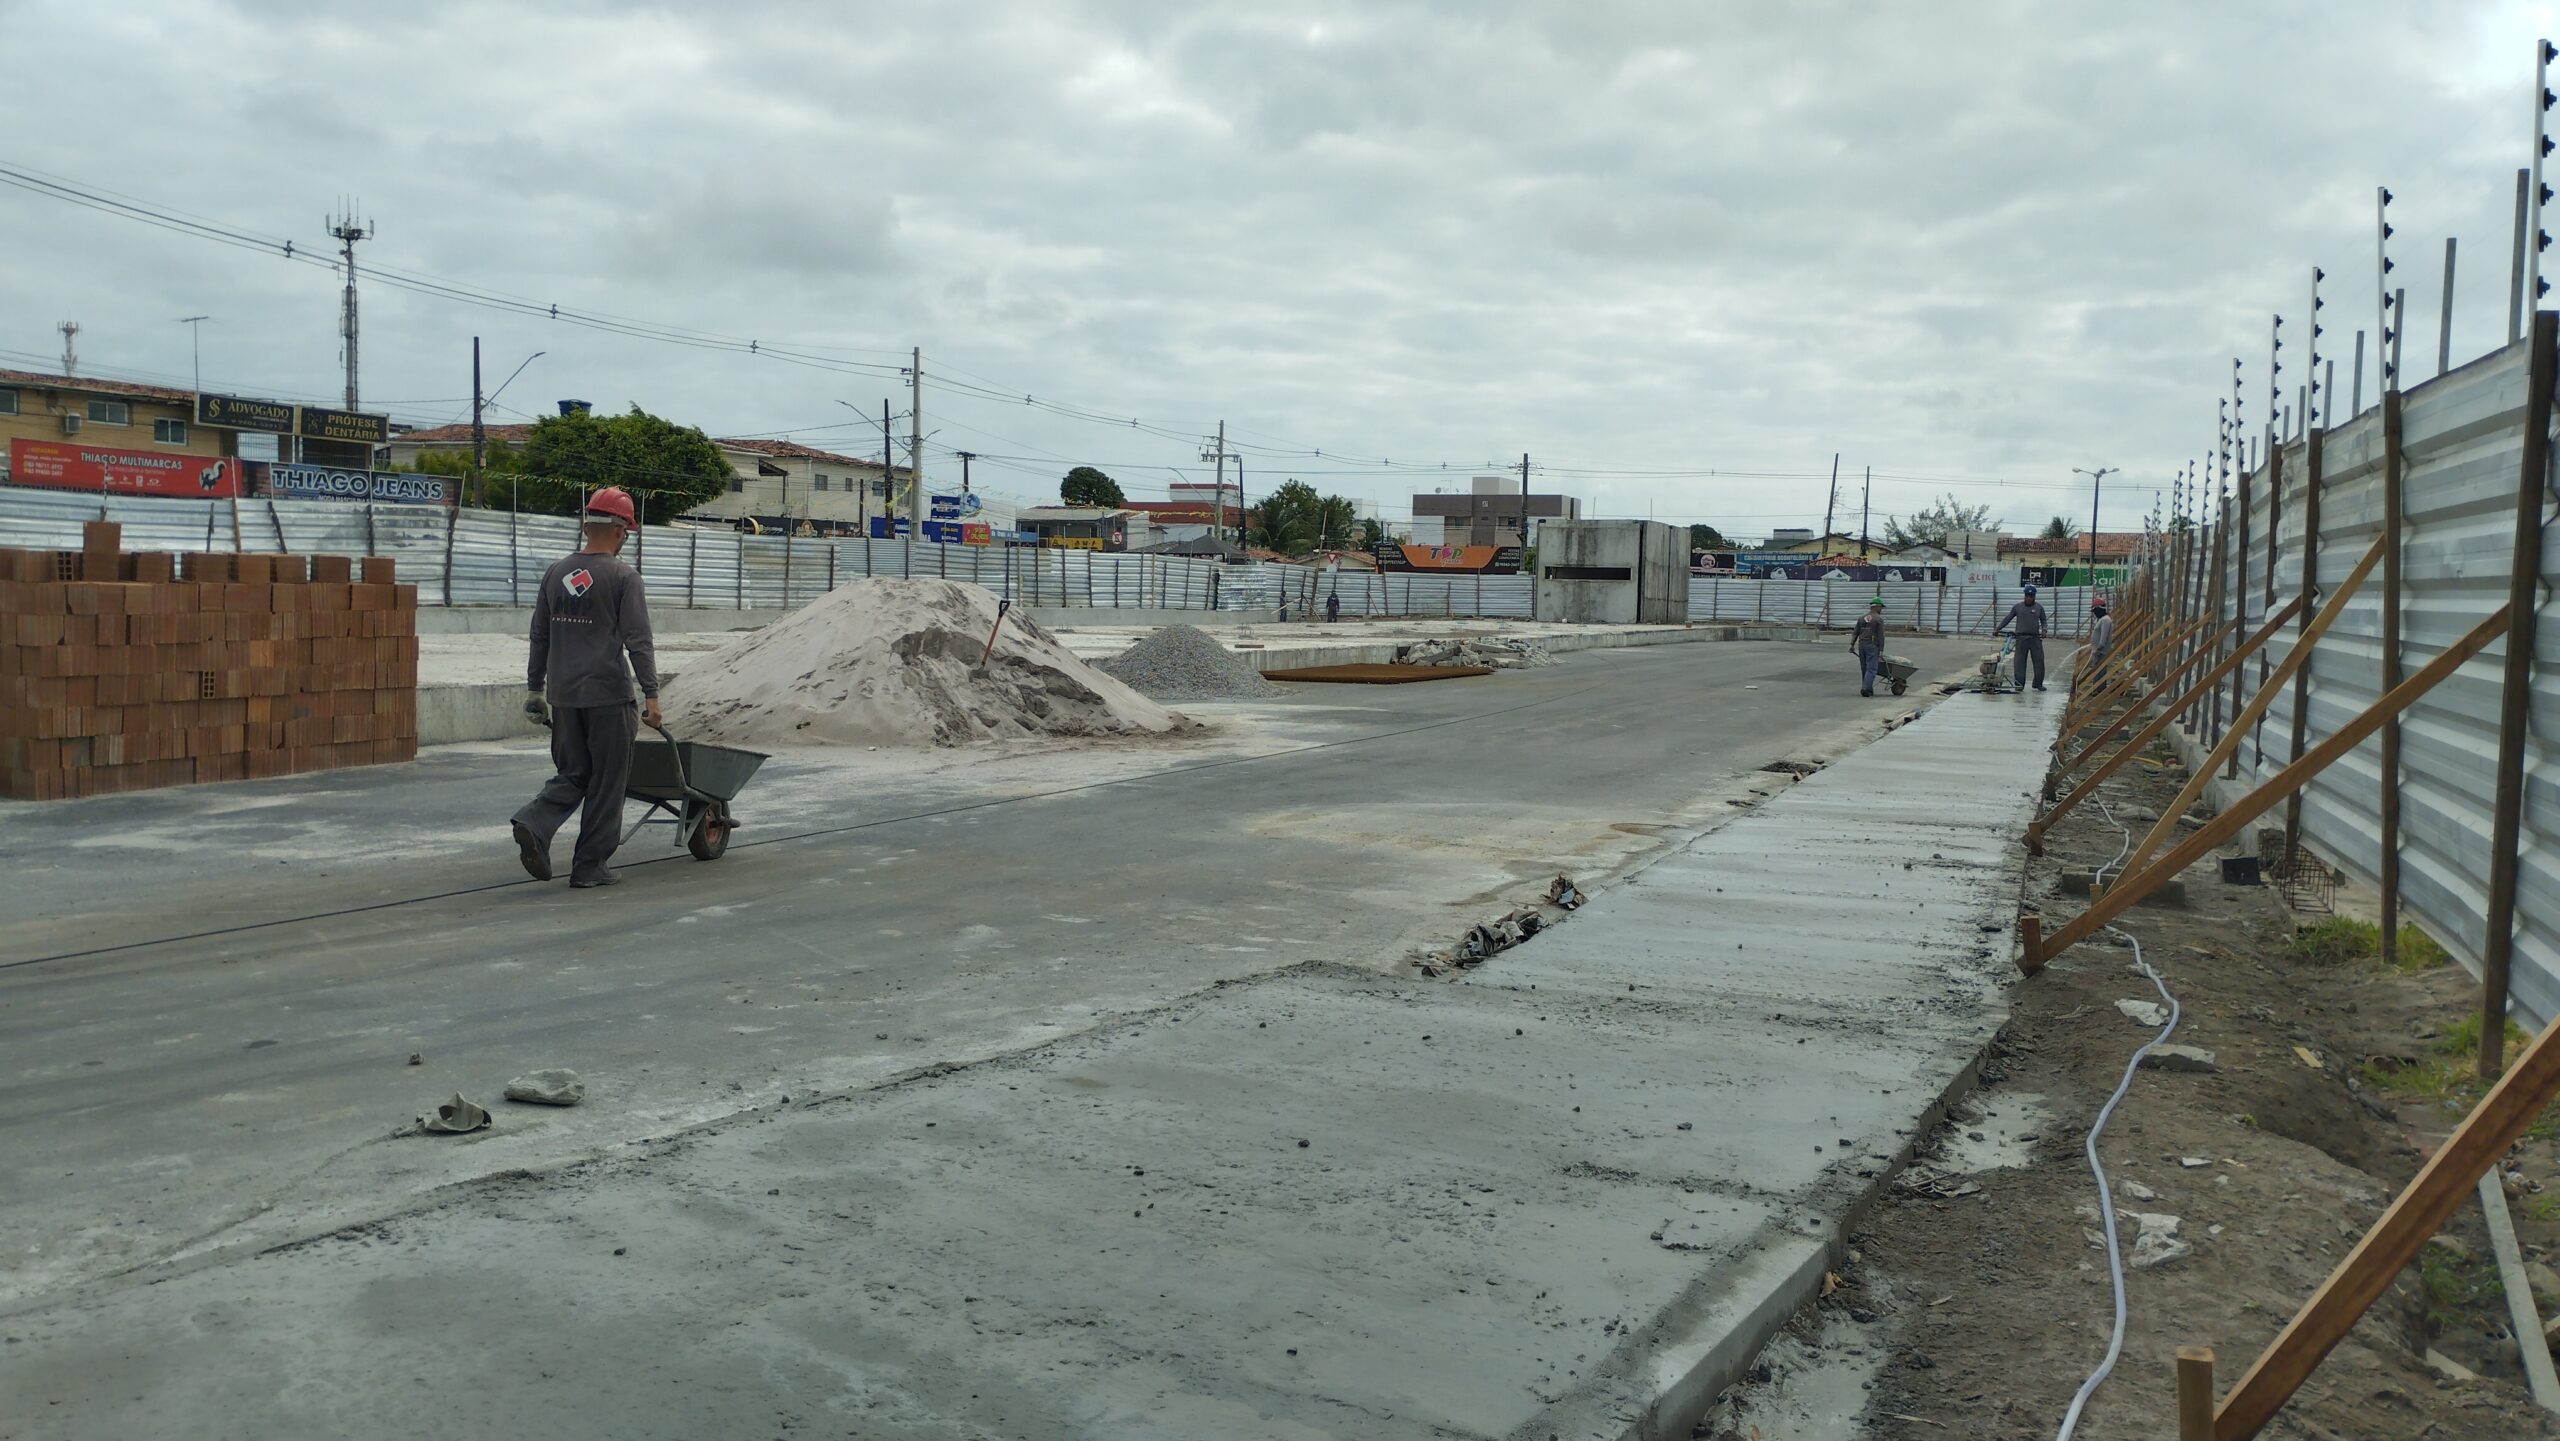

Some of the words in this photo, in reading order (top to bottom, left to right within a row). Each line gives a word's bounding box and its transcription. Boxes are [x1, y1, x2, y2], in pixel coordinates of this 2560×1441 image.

[227, 401, 290, 418] ADVOGADO
[327, 414, 379, 429] PRÓTESE
[324, 425, 381, 441] DENTÁRIA
[80, 451, 117, 465] THIAGO
[119, 456, 183, 470] MULTIMARCAS
[272, 469, 369, 495] THIAGO
[374, 477, 444, 500] JEANS
[1976, 573, 1997, 581] LIKE
